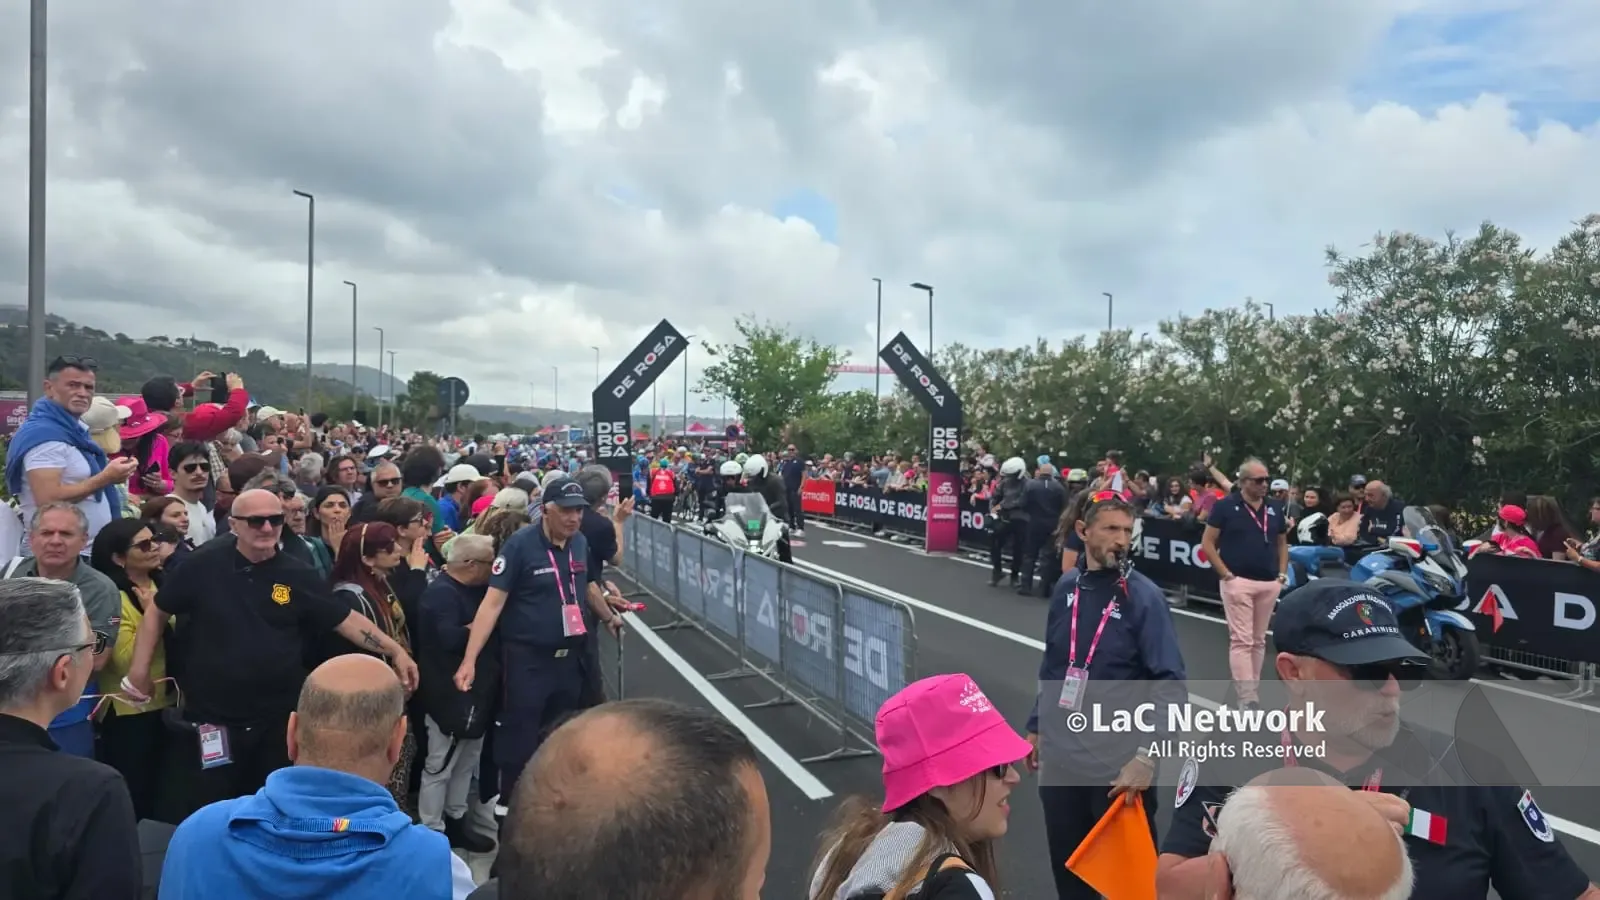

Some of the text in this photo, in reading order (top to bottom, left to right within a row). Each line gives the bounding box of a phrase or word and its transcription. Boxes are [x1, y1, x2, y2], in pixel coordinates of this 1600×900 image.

[612, 335, 677, 398] DE ROSA
[892, 343, 945, 407] DE ROSA
[597, 421, 626, 434] DE
[933, 427, 958, 439] DE
[598, 434, 629, 446] RO
[933, 439, 959, 450] RO
[598, 446, 629, 458] SA
[932, 450, 959, 460] SA
[835, 491, 848, 506] DE
[850, 494, 878, 513] ROSA
[879, 498, 896, 516] DE
[961, 510, 985, 530] RO
[1553, 591, 1597, 630] D
